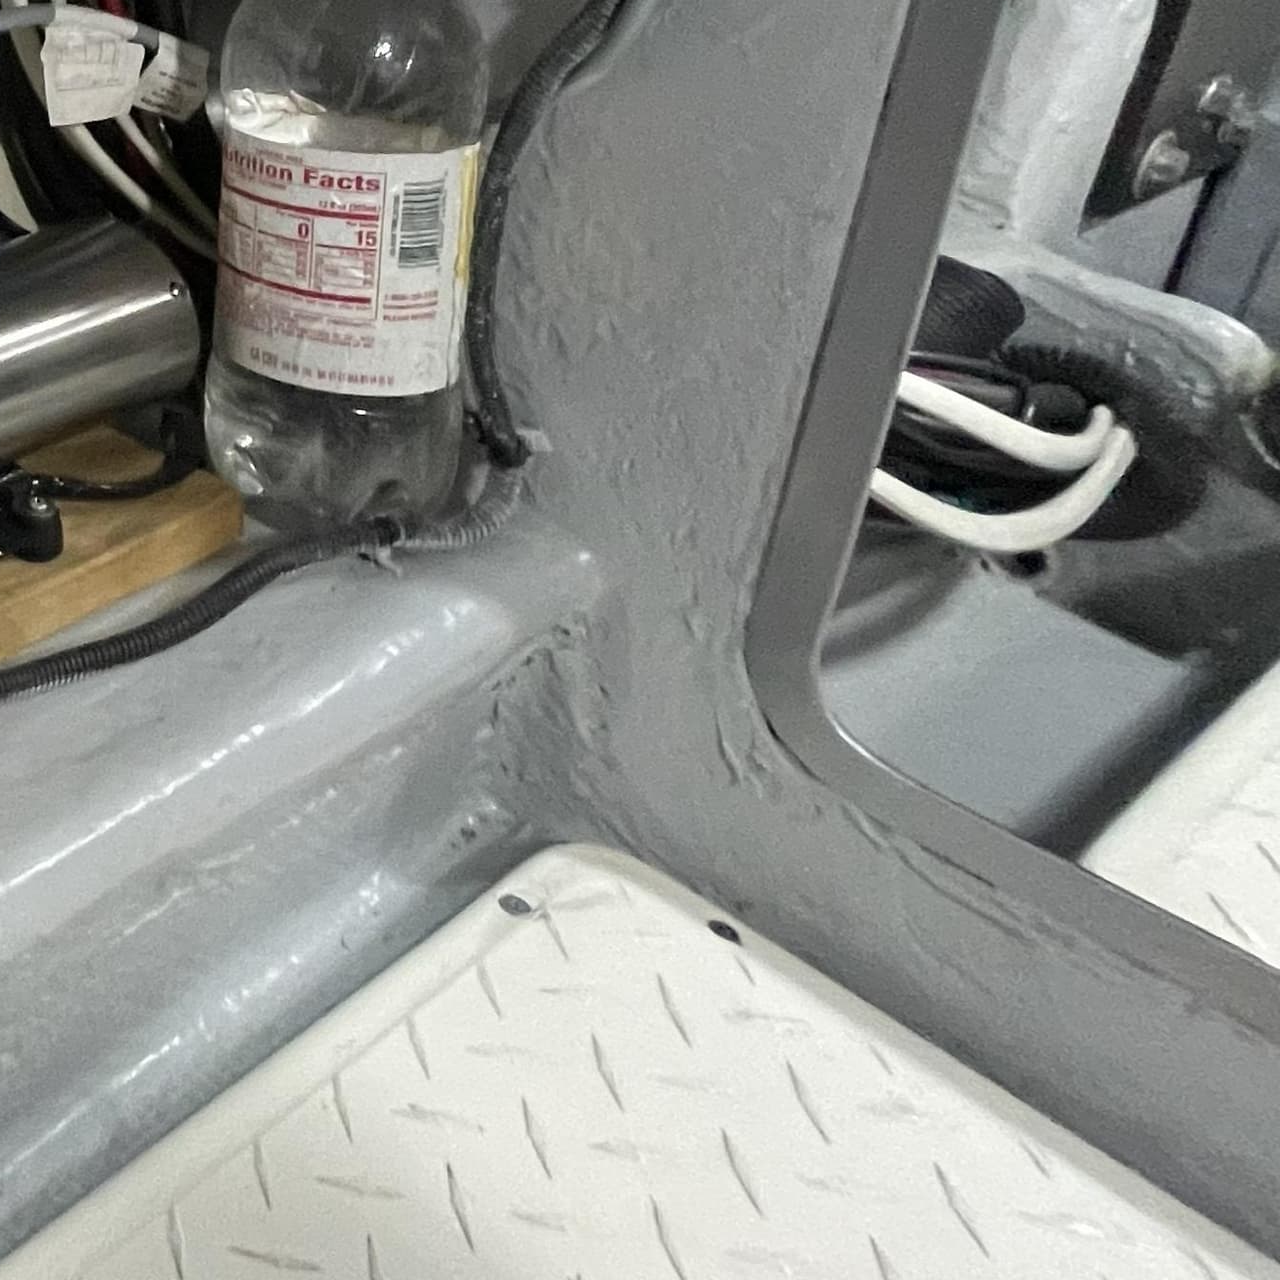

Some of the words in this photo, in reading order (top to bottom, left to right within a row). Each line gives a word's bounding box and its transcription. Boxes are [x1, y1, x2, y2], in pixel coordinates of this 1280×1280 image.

[303, 168, 381, 192] Facts
[297, 222, 310, 239] 0
[357, 230, 378, 247] 15
